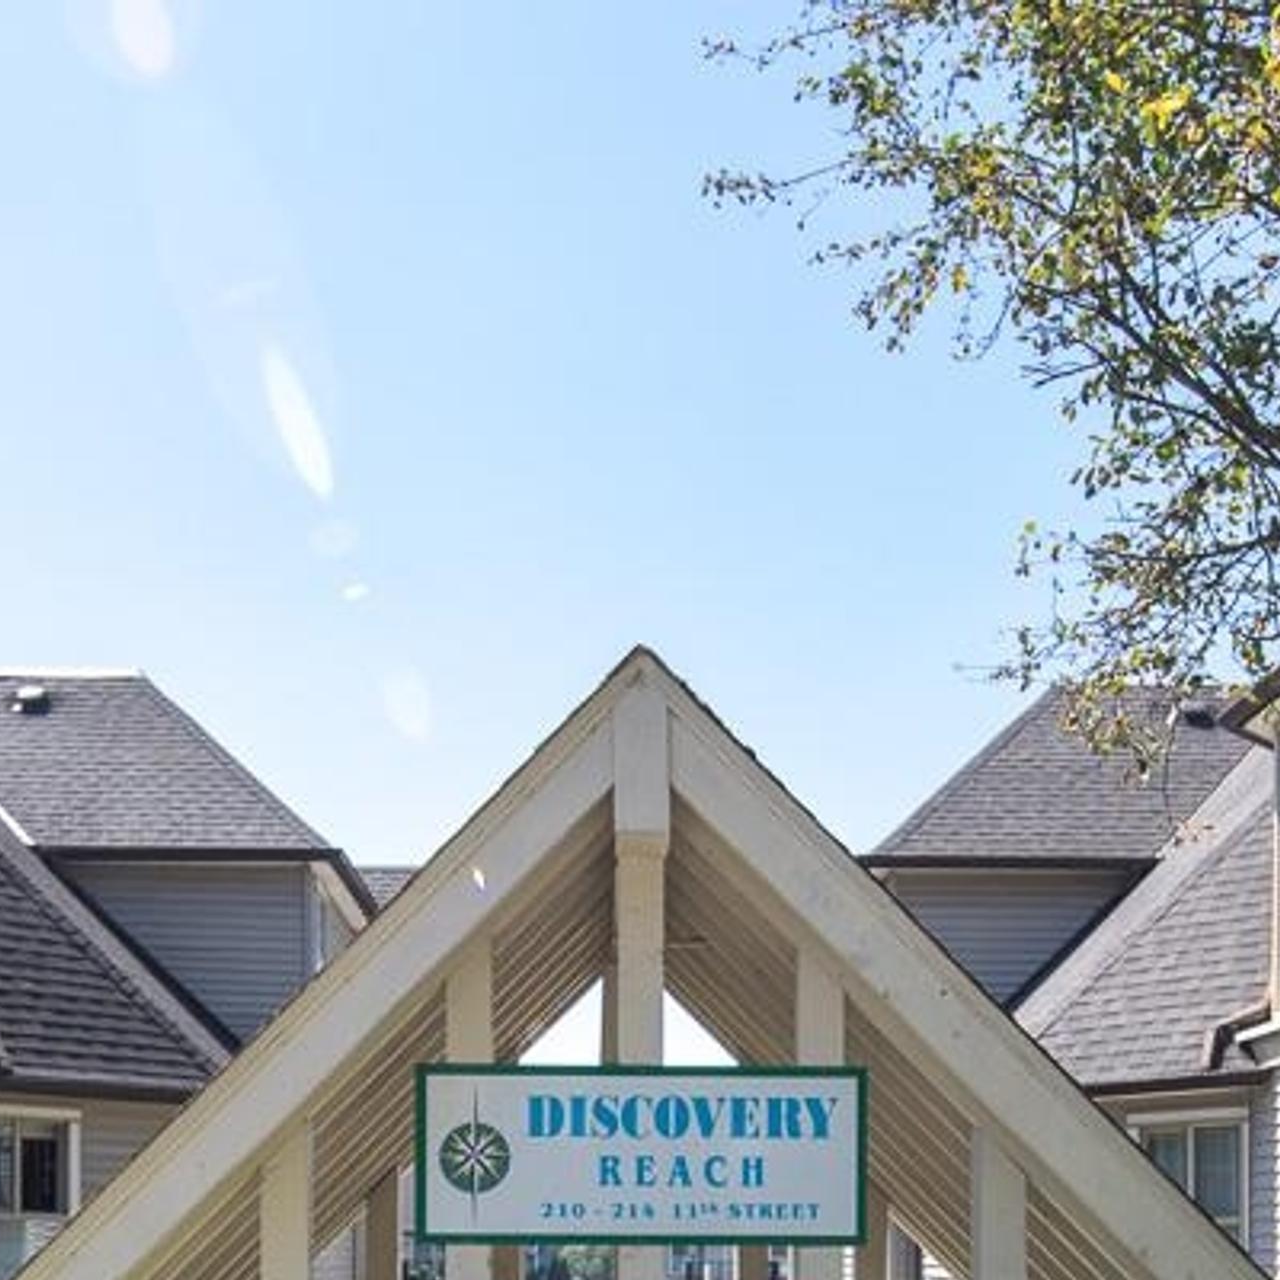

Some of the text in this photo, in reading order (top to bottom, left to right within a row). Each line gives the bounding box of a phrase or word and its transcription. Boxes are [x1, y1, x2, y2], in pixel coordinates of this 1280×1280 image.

[526, 1095, 838, 1139] DISCOVERY
[598, 1155, 764, 1187] REACH
[727, 1202, 820, 1220] STREET
